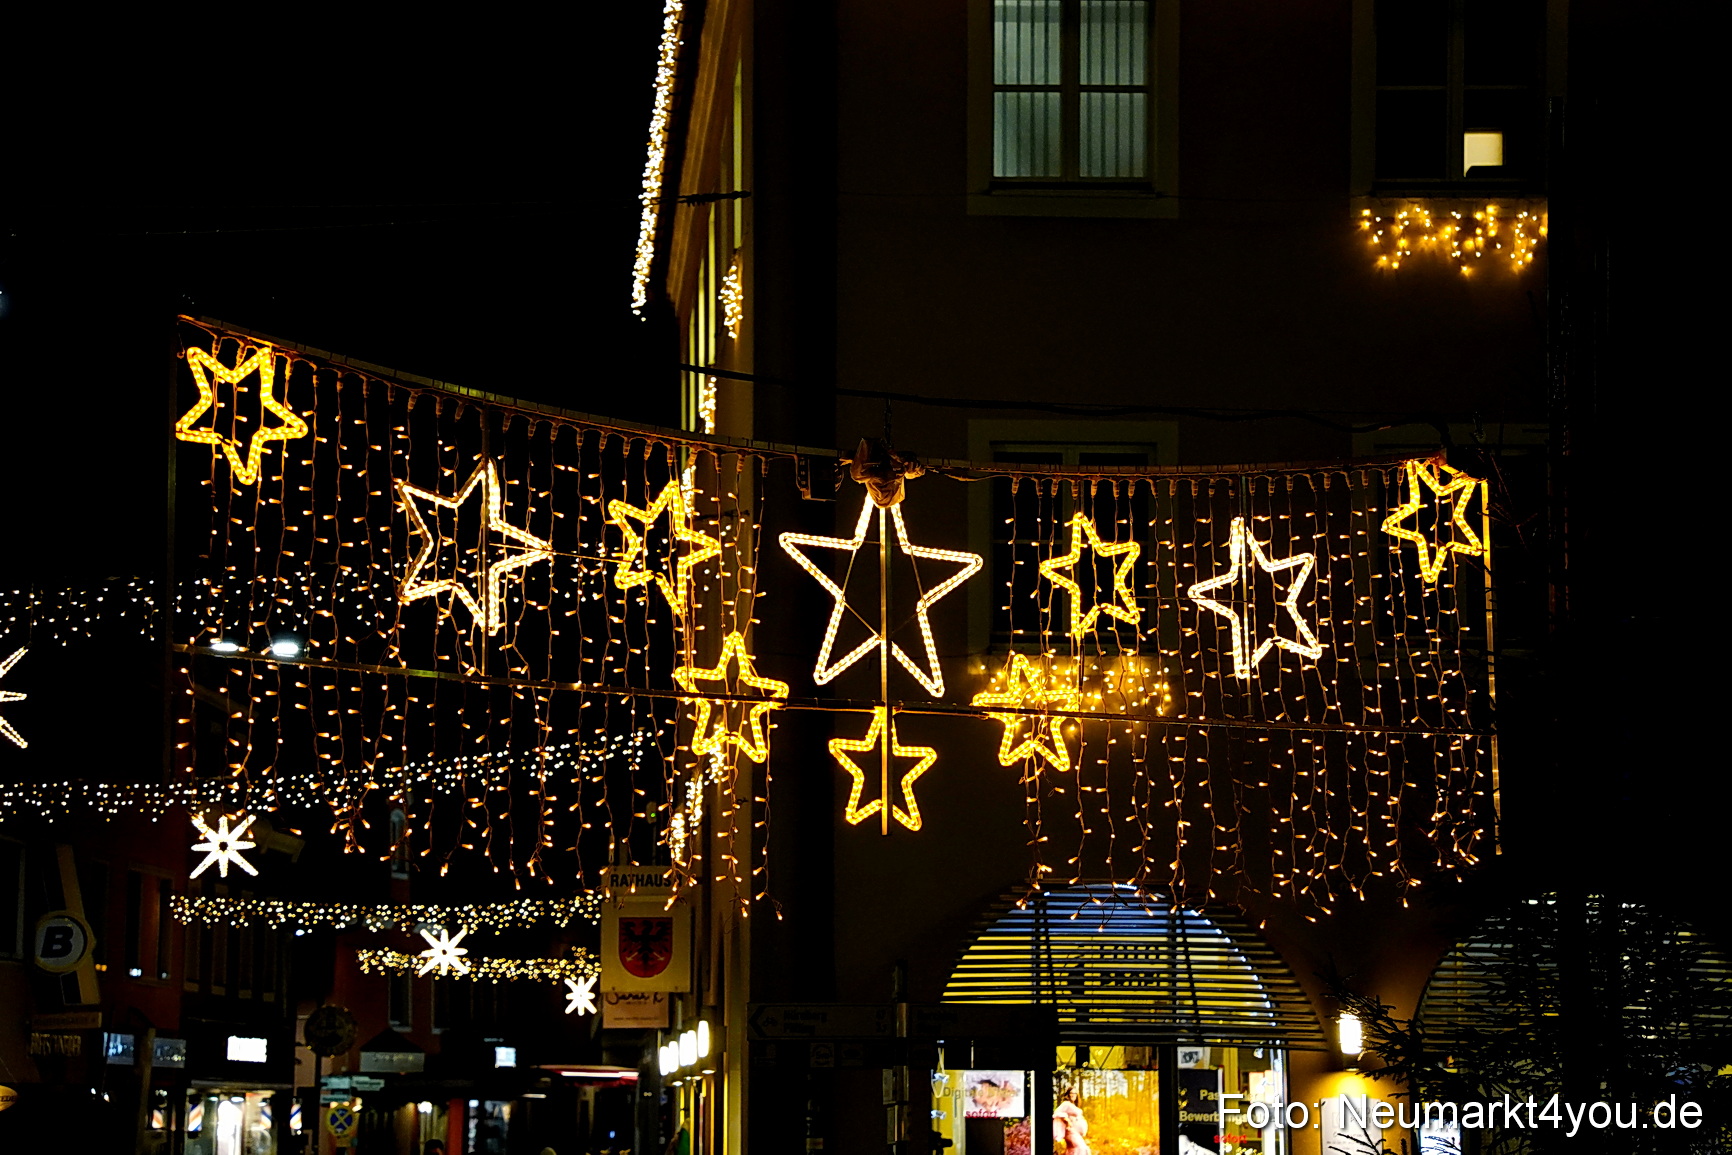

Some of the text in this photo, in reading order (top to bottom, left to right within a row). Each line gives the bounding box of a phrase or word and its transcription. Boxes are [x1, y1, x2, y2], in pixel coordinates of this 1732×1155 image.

[610, 873, 672, 887] RATHAUS
[40, 926, 74, 958] B
[965, 1108, 998, 1119] sofort
[1213, 1131, 1248, 1144] sofort
